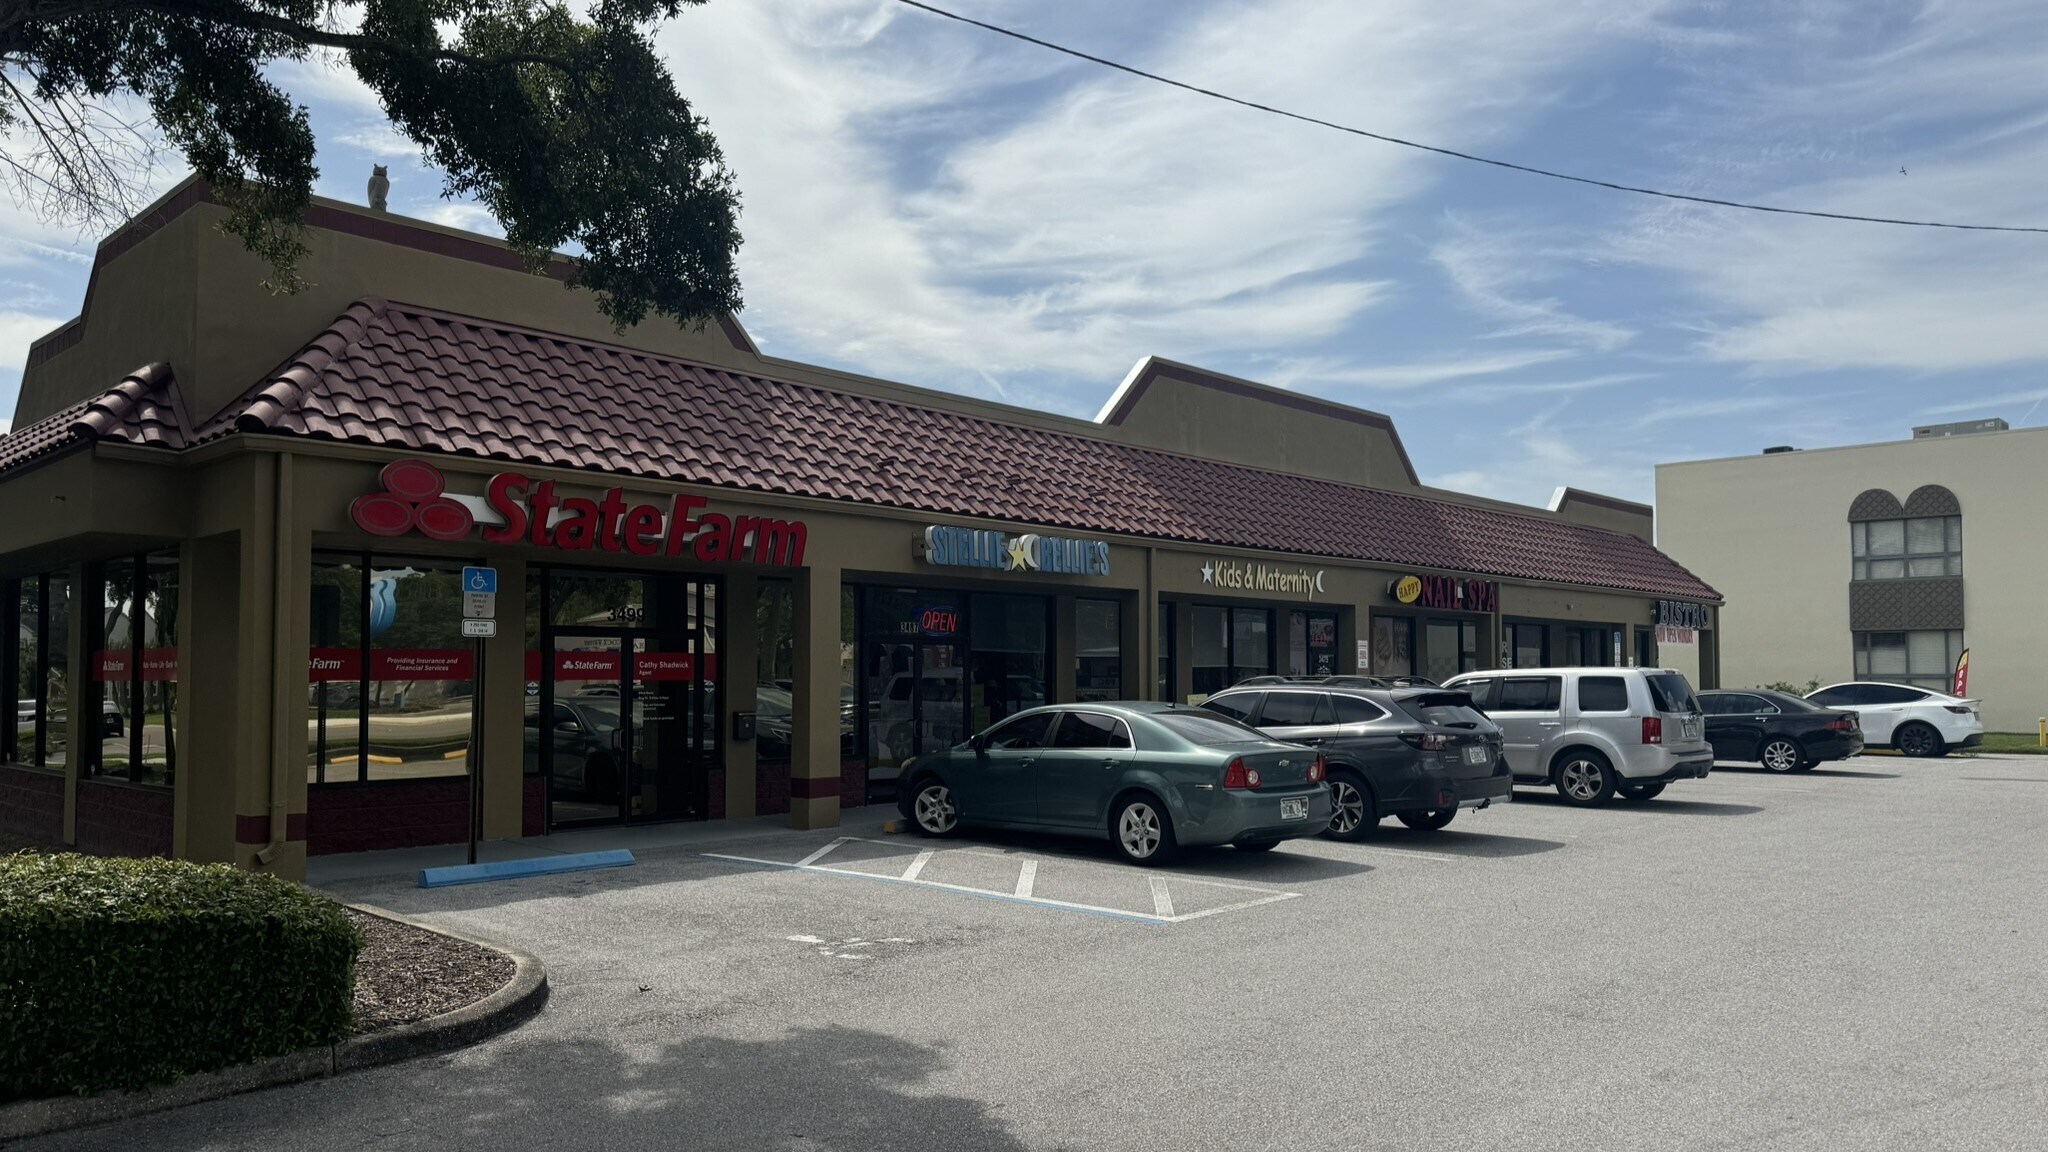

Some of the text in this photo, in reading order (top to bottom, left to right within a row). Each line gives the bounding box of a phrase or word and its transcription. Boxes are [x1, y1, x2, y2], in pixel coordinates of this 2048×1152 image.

[927, 524, 1109, 577] STELLIE BELLIE'S
[1214, 560, 1315, 601] Kids & Maternity
[1398, 581, 1419, 599] HAPPY
[1421, 573, 1497, 612] NAIL SPA
[607, 606, 646, 622] 3499
[922, 610, 958, 633] OPEN
[1659, 600, 1709, 628] BISTRO
[387, 657, 459, 665] Providing Insurance and
[639, 661, 689, 670] Cathy Shadwick
